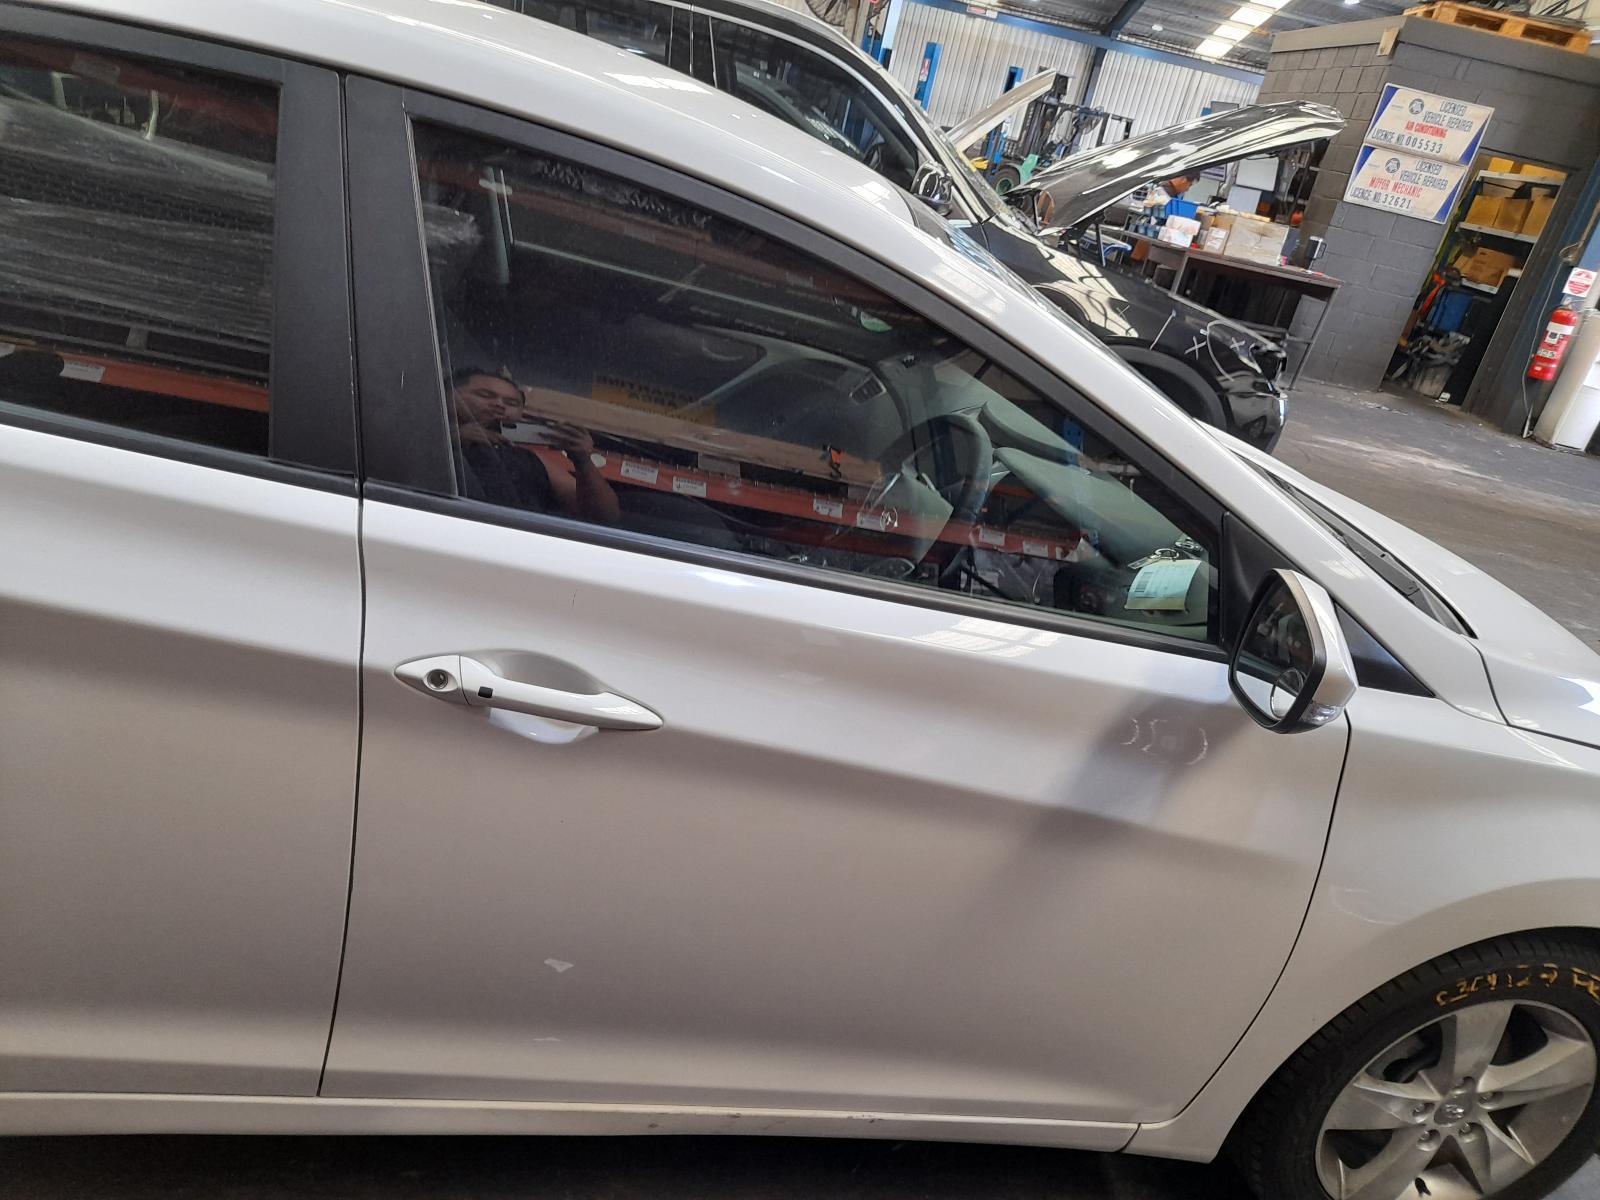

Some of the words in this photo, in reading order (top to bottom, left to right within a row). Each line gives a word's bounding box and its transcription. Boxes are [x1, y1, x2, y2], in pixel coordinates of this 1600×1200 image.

[1405, 136, 1443, 153] 005533
[1369, 176, 1391, 189] MOTOR
[1391, 182, 1423, 198] MECHANIC
[1382, 194, 1412, 209] 32621
